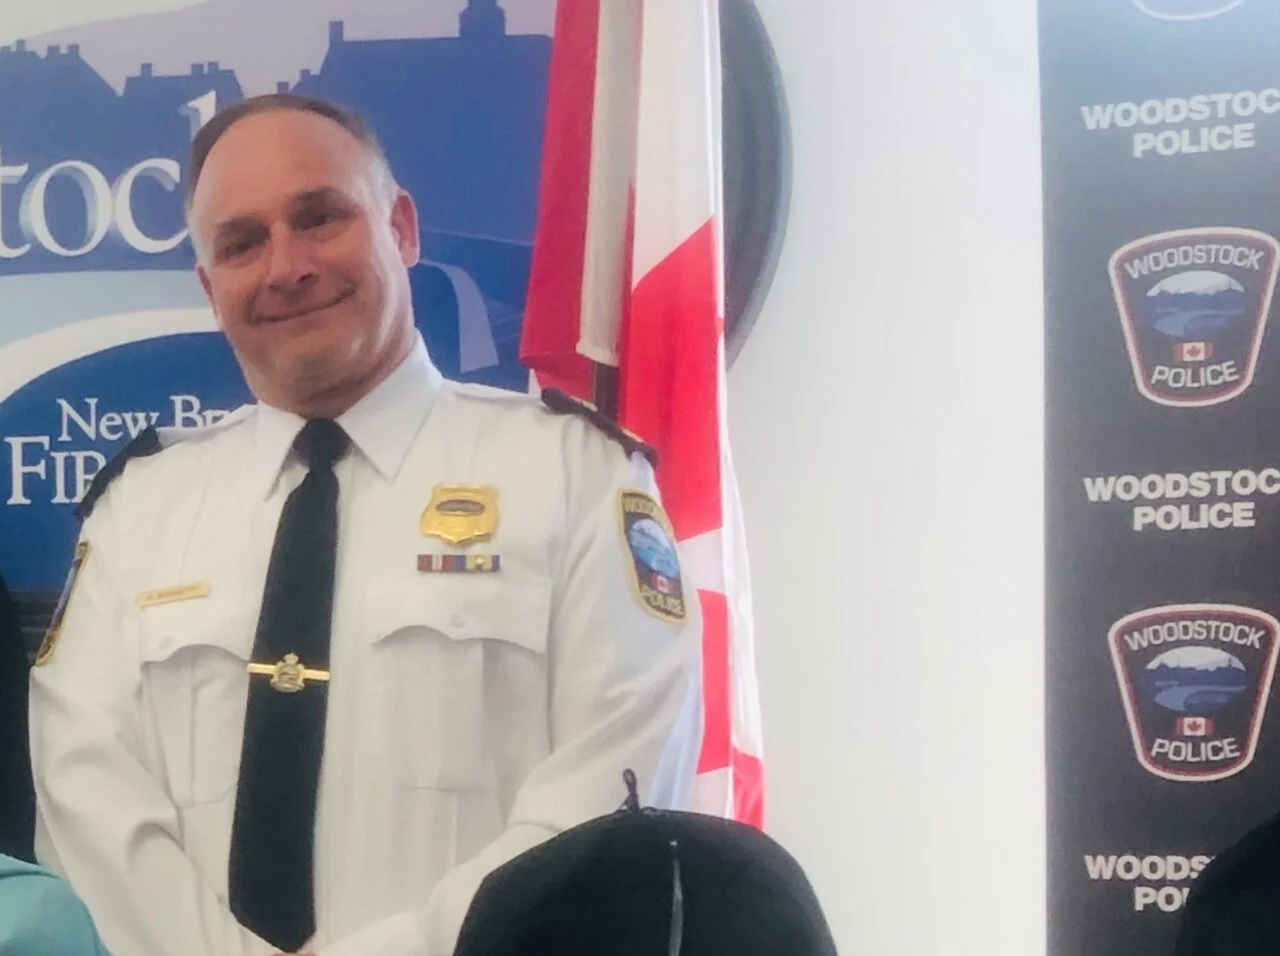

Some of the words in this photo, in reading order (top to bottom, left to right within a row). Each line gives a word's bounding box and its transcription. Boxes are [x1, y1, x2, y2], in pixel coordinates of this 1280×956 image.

[1081, 88, 1280, 130] WOODSTOC
[1132, 123, 1255, 157] POLICE
[1125, 244, 1264, 280] WOODSTOCK
[1151, 360, 1240, 389] POLICE
[56, 397, 160, 442] New
[1083, 468, 1280, 502] WOODSTOC
[1133, 502, 1255, 531] POLICE
[1124, 620, 1265, 652] WOODSTOCK
[1151, 737, 1240, 762] POLICE
[1084, 854, 1216, 880] WOODS
